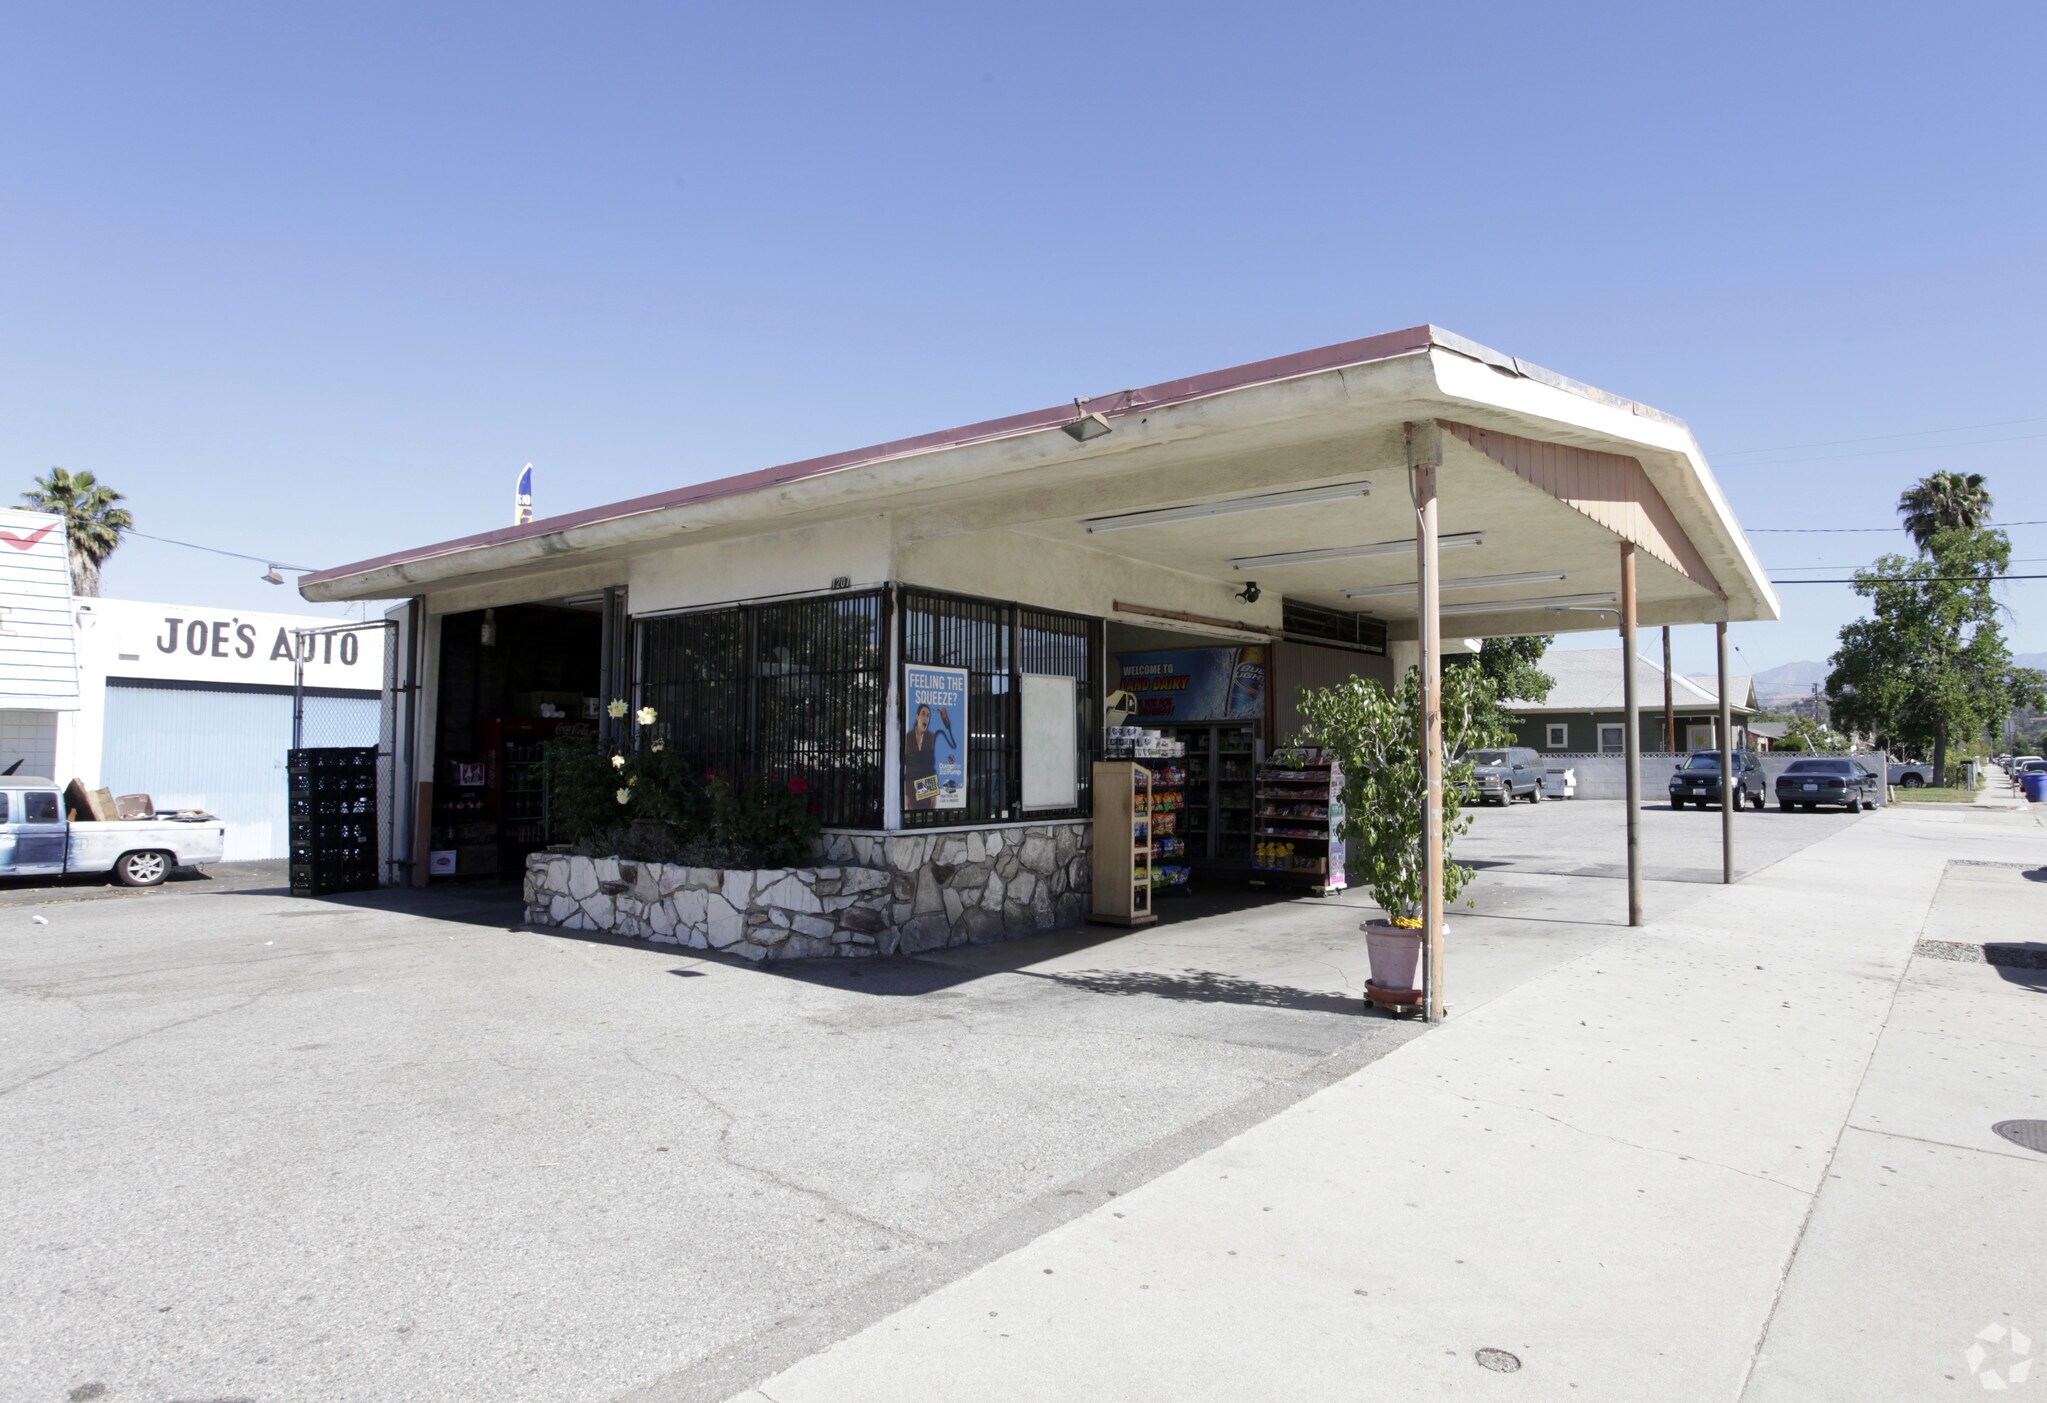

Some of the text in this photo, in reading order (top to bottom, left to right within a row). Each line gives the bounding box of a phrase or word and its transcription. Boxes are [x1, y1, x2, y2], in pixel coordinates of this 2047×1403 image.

[832, 577, 850, 590] 1207
[157, 617, 358, 665] JOE'S AUTO
[1123, 664, 1174, 676] WELCOME TO
[910, 673, 964, 691] FEELING THE
[1152, 675, 1190, 691] DAIRY
[915, 690, 958, 706] SQUEEZE?
